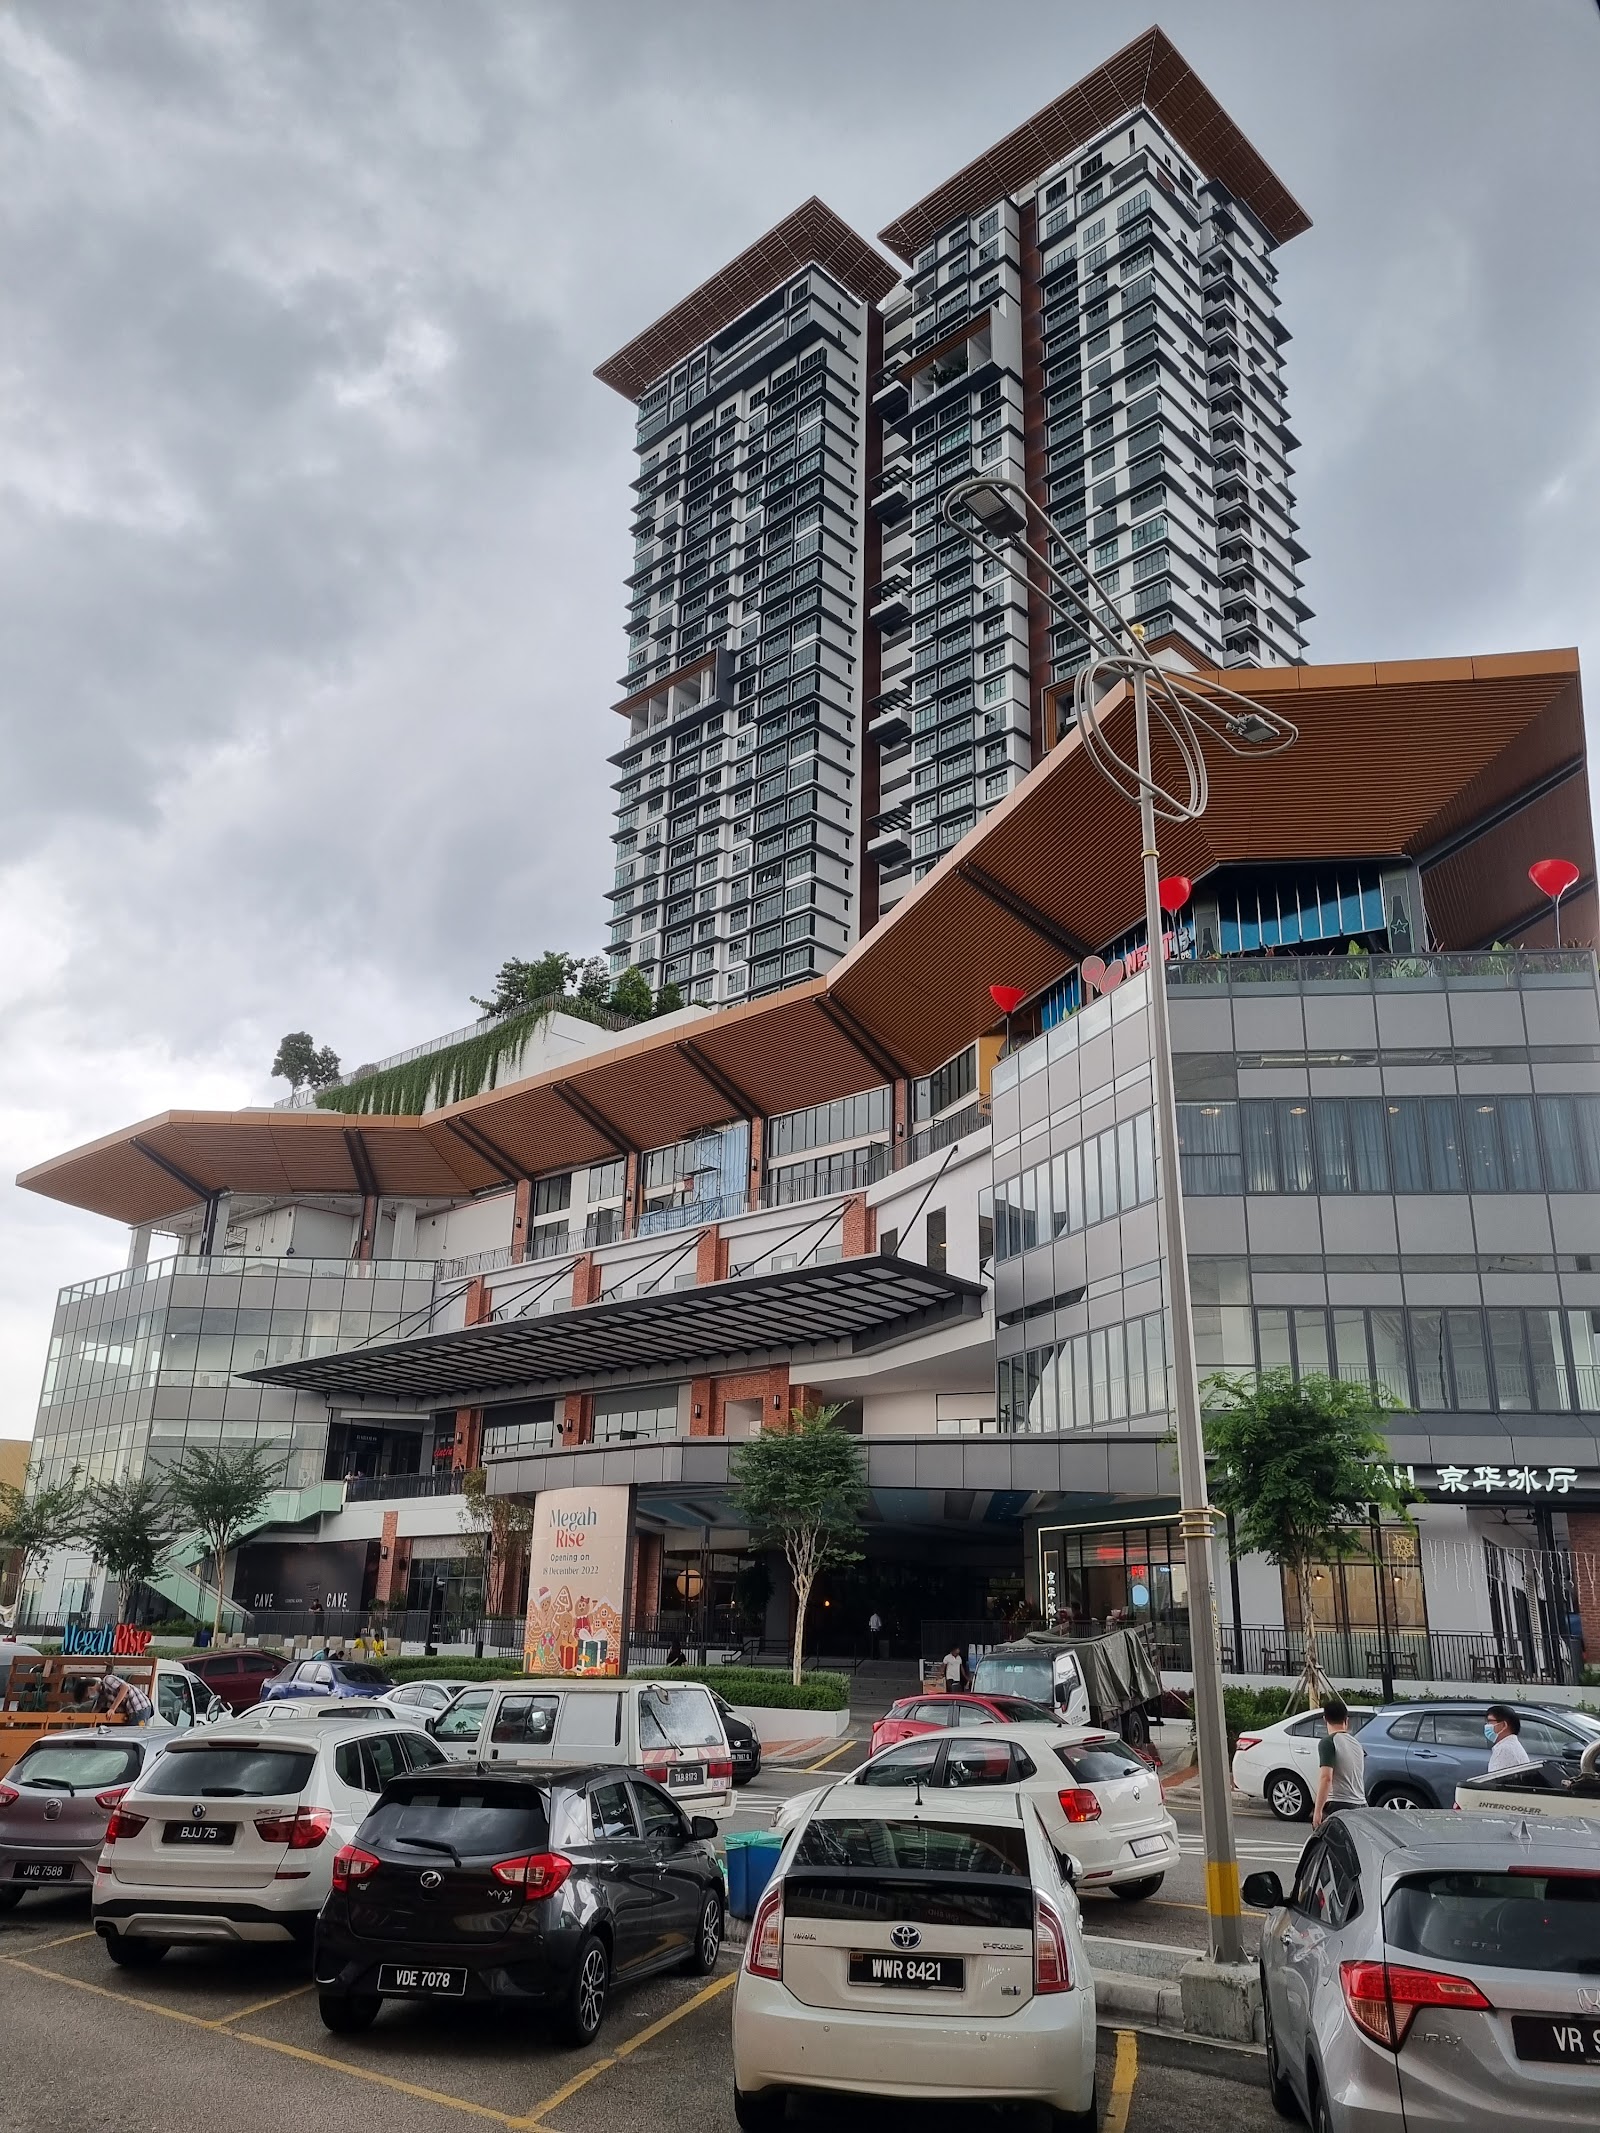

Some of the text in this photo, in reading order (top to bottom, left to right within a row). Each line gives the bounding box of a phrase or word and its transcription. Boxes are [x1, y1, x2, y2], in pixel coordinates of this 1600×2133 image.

[1436, 1465, 1578, 1495] 京华冰厅
[549, 1506, 597, 1532] Megah
[556, 1528, 585, 1548] Rise
[550, 1553, 578, 1563] Opening
[549, 1566, 579, 1575] December
[581, 1565, 599, 1575] 2022
[254, 1593, 274, 1608] CAVE
[326, 1592, 348, 1608] CAVE
[256, 1808, 283, 1816] X3
[1479, 1801, 1542, 1815] INTERCOOLER
[180, 1826, 218, 1839] BJJ 75
[23, 1864, 63, 1876] JVG 7588
[982, 1942, 1024, 1951] PRIUS
[872, 1958, 942, 1982] WWR 8421
[396, 1969, 451, 1988] VDE 7078
[1552, 2025, 1585, 2054] VR
